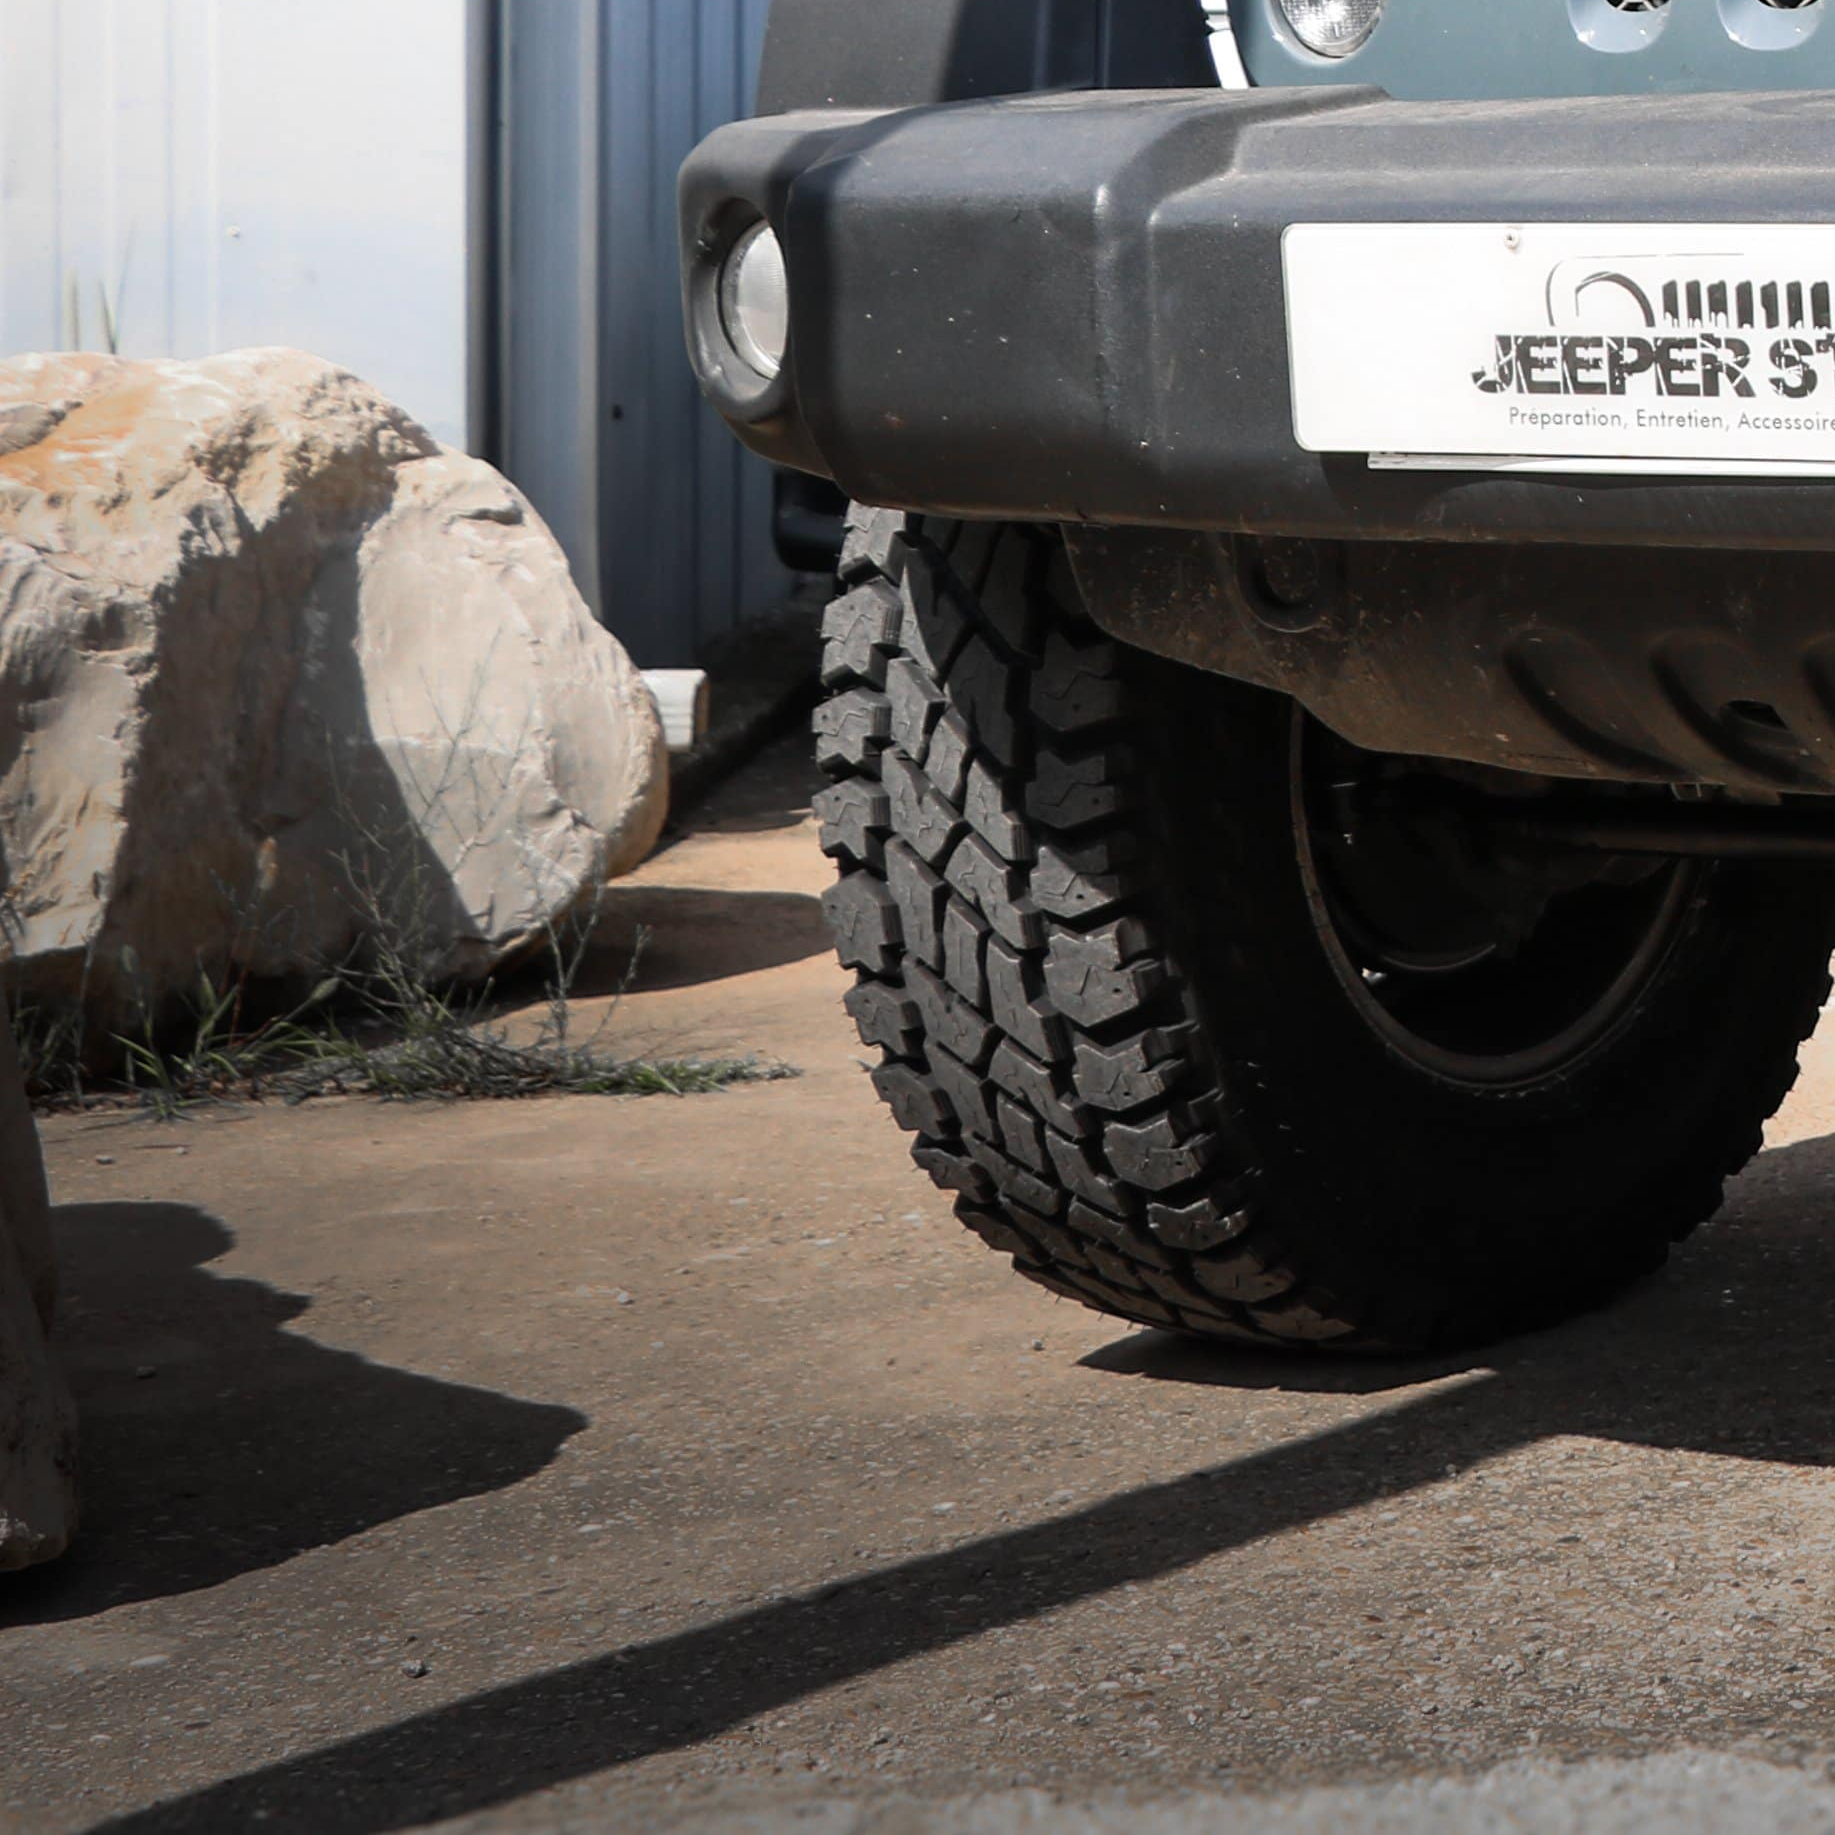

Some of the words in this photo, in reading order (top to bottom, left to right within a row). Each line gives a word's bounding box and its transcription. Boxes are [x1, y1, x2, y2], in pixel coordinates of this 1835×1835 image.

[1471, 332, 1757, 398] JEEPER
[1508, 406, 1628, 429] Préparation,
[1636, 408, 1730, 432] Entretien,
